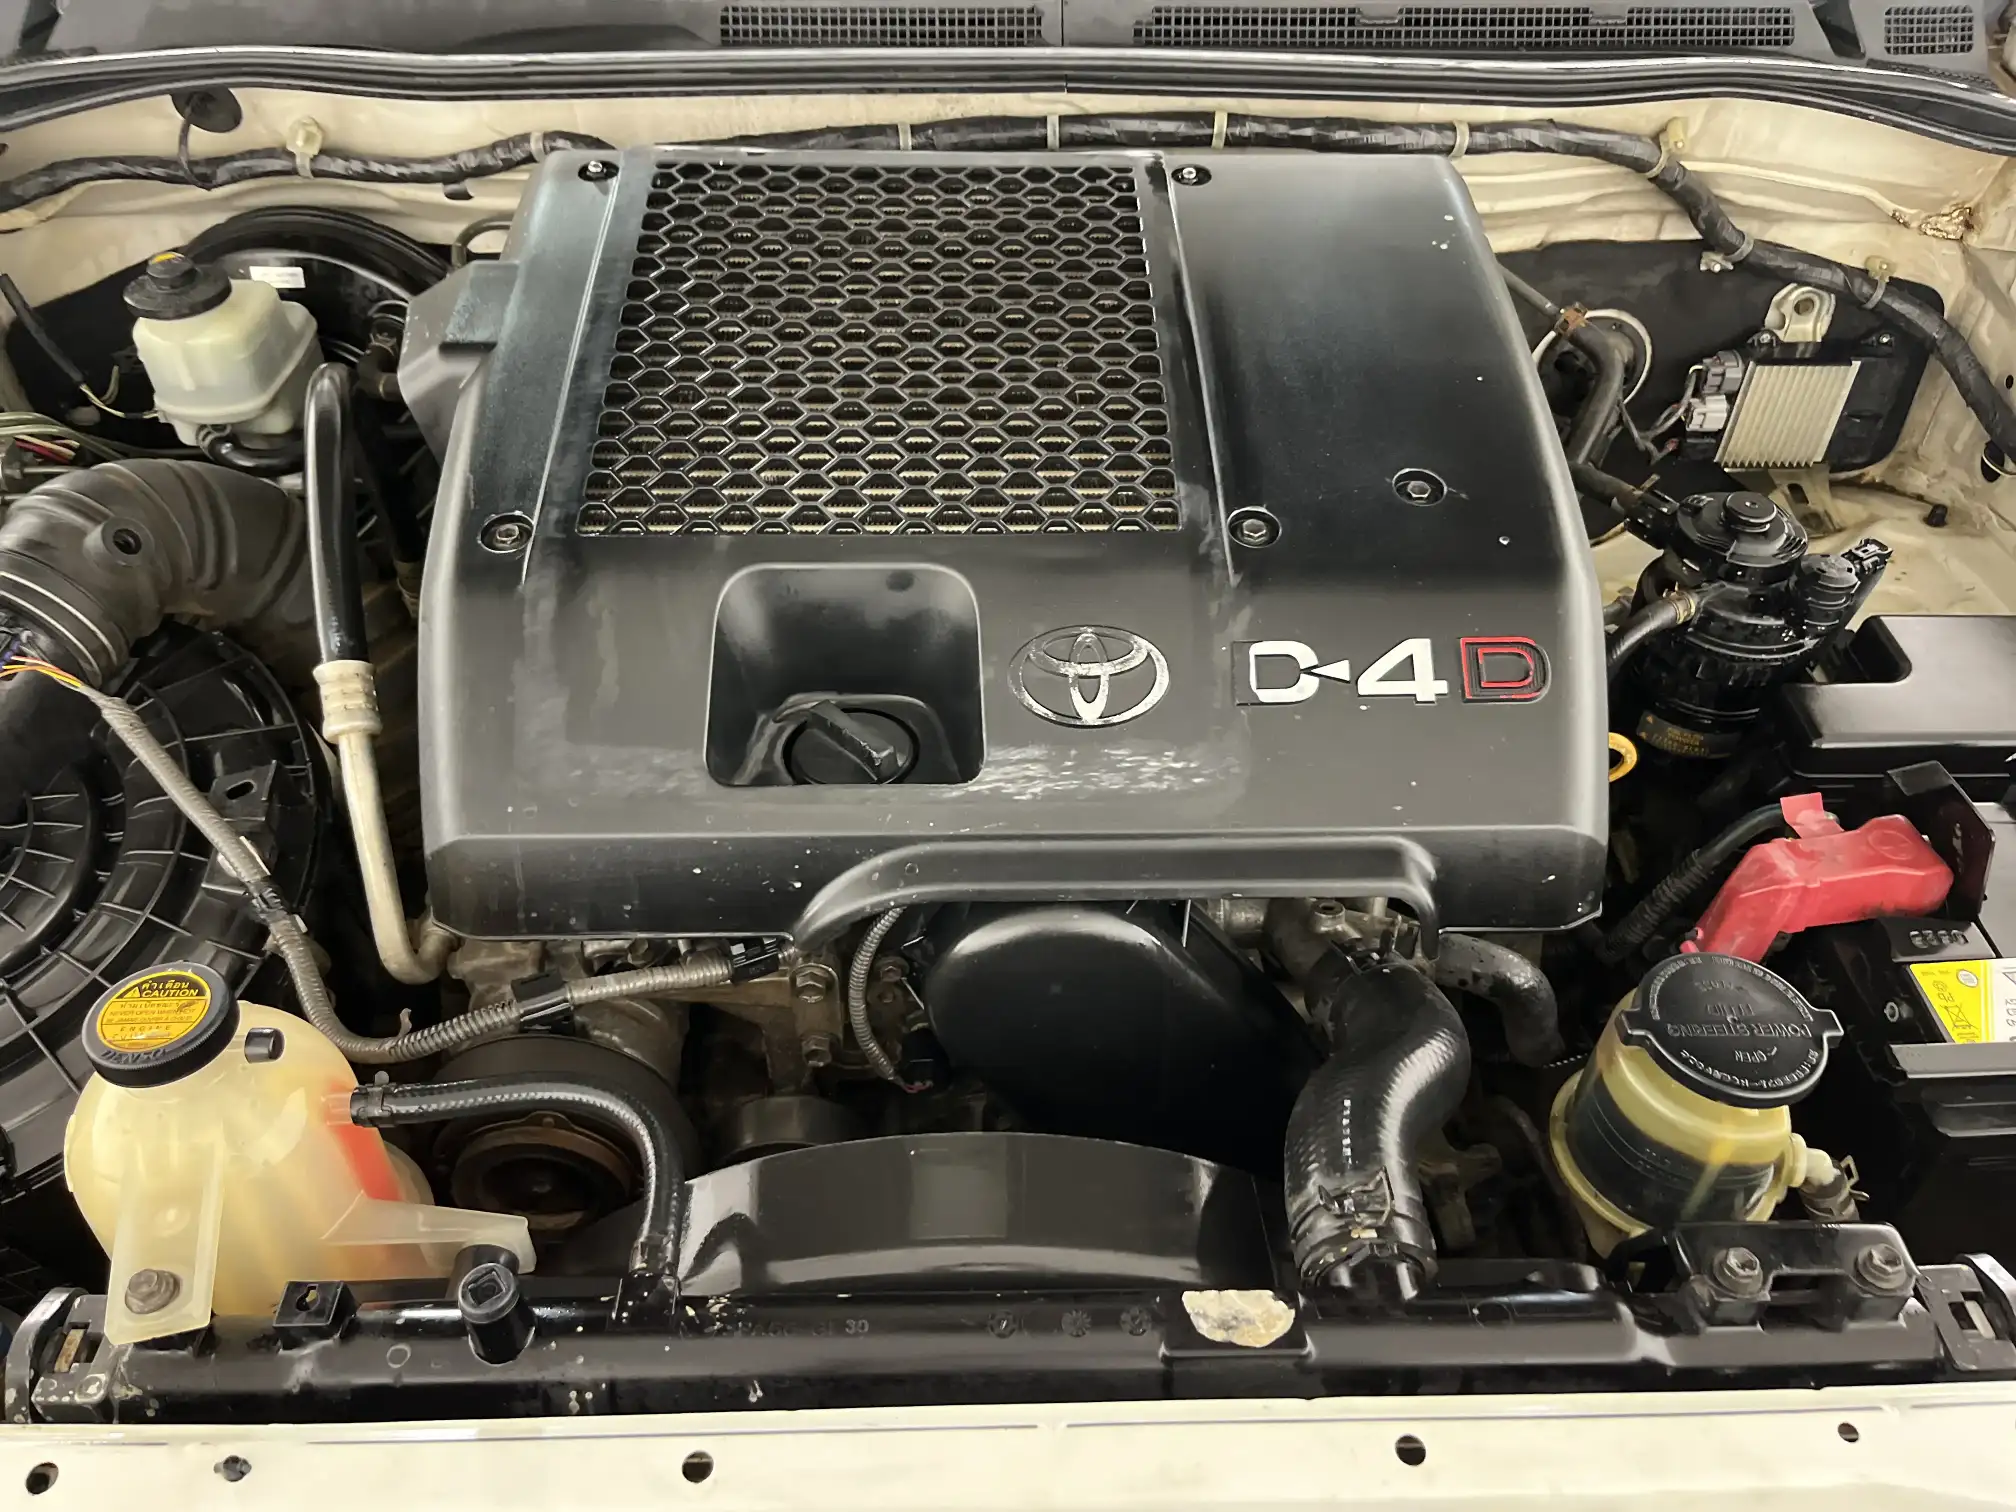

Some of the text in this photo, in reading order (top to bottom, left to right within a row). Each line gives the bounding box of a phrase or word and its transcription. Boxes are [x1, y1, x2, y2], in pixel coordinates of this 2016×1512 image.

[141, 989, 199, 997] CAUTION
[1667, 1023, 1812, 1038] POWER STEERING
[101, 1048, 167, 1064] DENSO
[1735, 1050, 1768, 1063] OPEN
